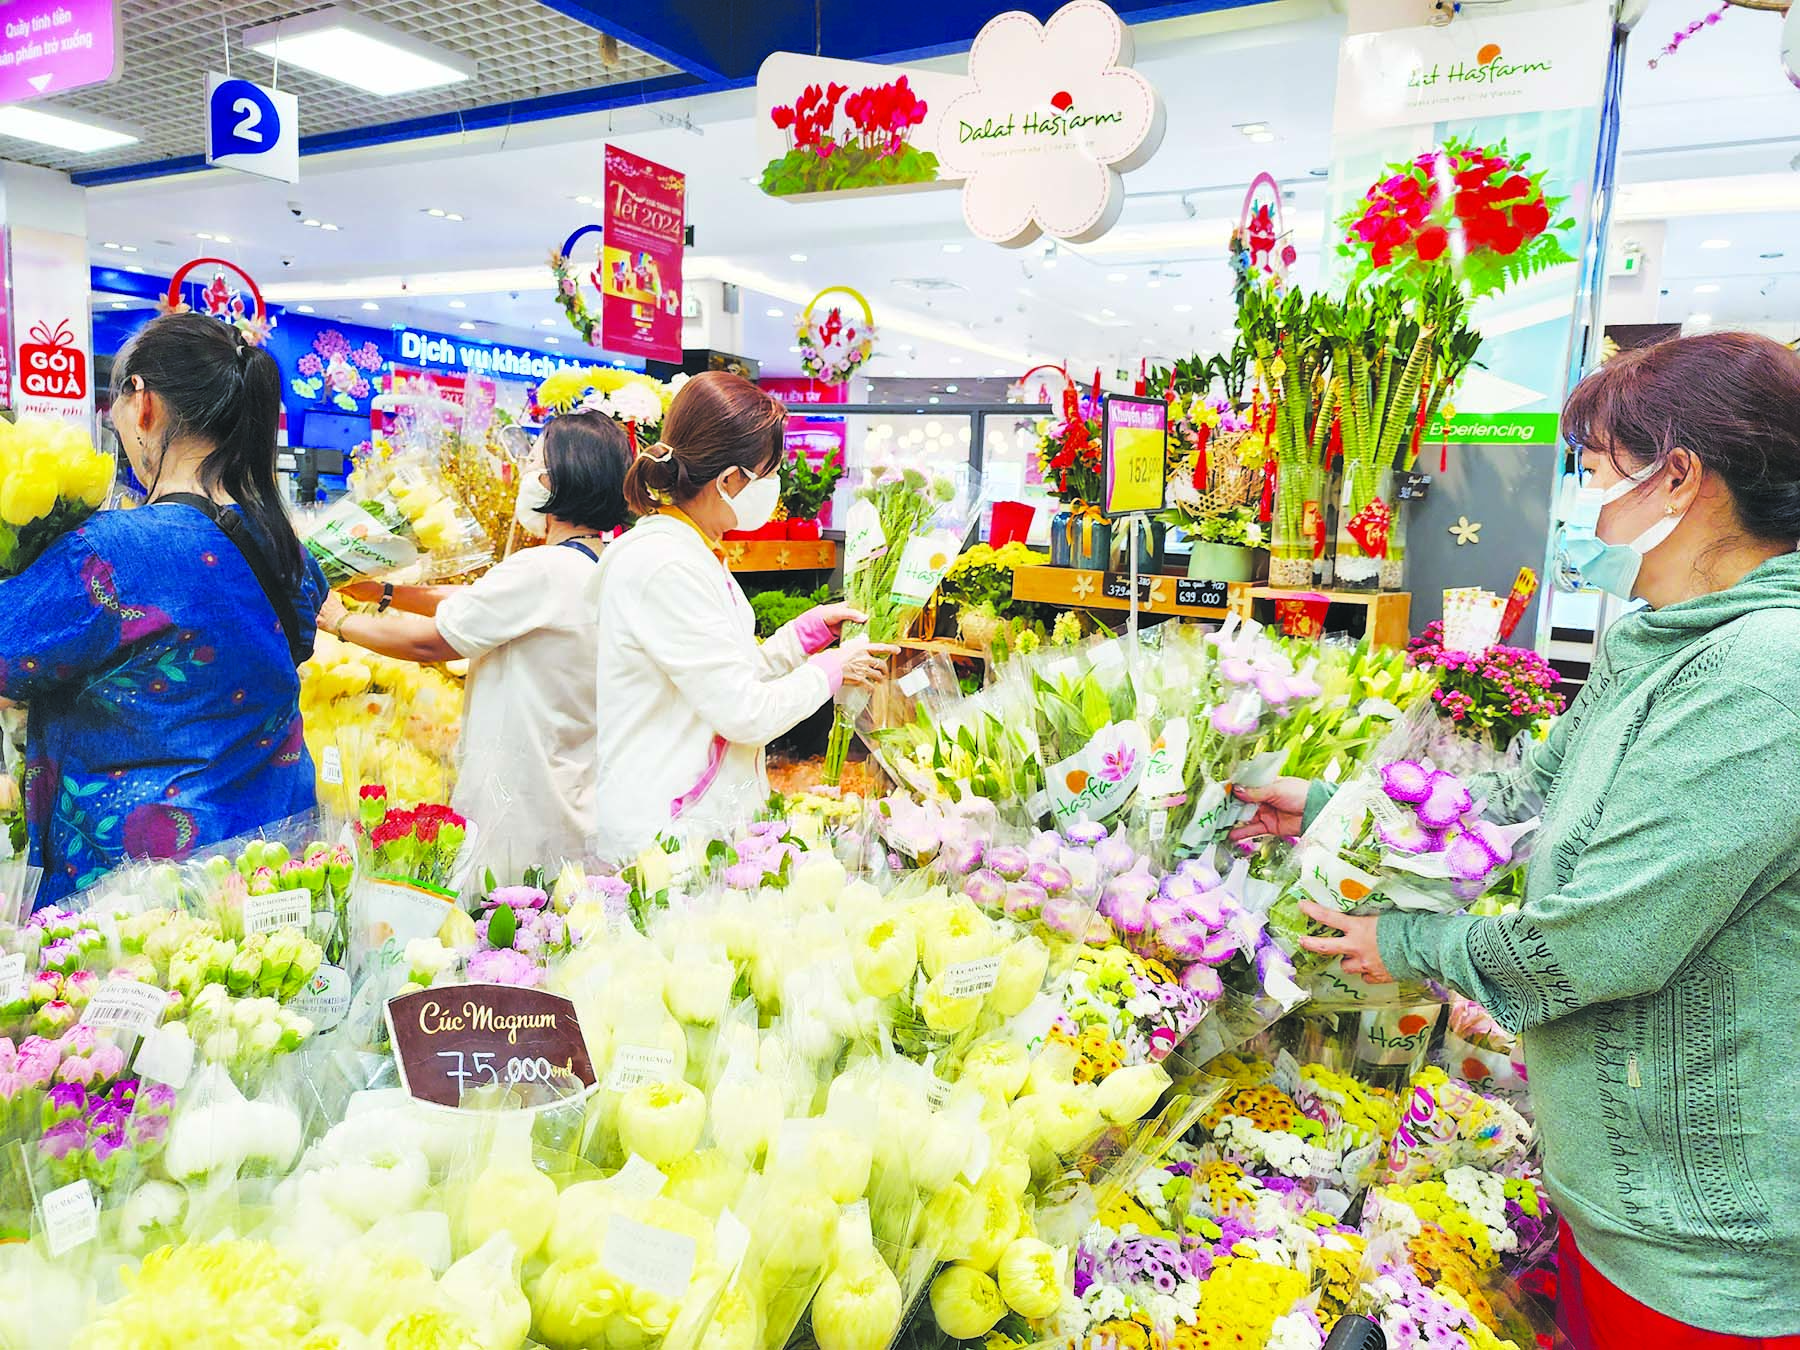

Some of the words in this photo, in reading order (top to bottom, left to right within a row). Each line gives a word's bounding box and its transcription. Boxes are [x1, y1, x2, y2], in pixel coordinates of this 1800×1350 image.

[1448, 56, 1552, 83] Hasfarm
[232, 97, 263, 143] 2
[959, 112, 1016, 144] Dalat
[1022, 105, 1122, 136] Hasfarm
[641, 207, 680, 236] 2024
[30, 350, 75, 372] GÓI
[401, 331, 455, 366] Dịch
[459, 346, 490, 374] vụ
[491, 347, 557, 379] khách
[26, 373, 81, 396] QUÀ
[419, 1001, 465, 1035] Cúc
[463, 1001, 557, 1044] Magnum
